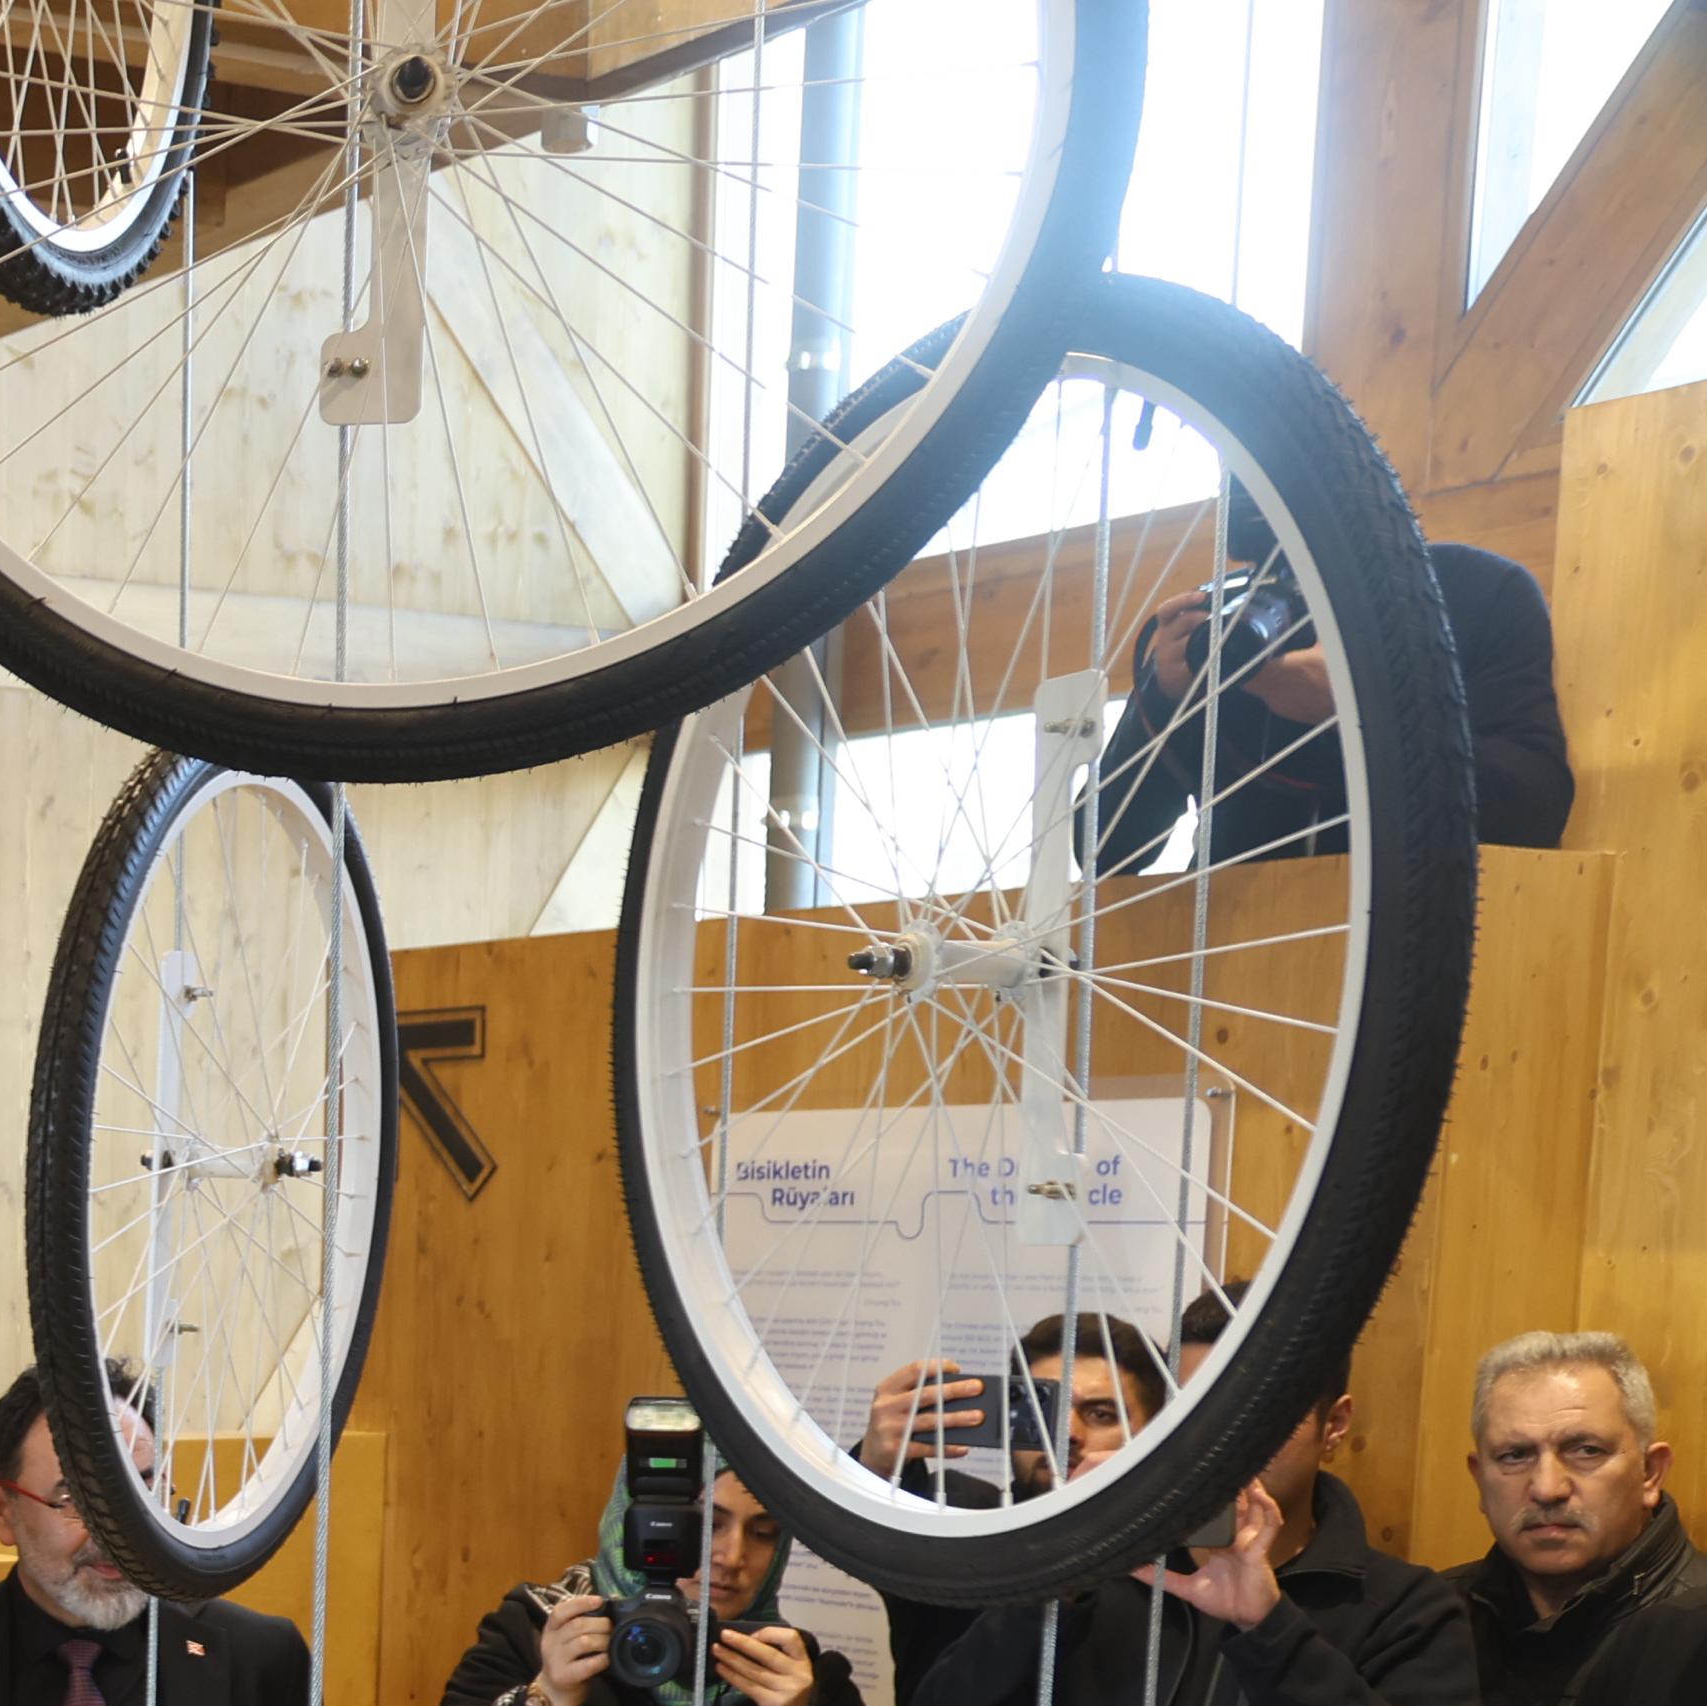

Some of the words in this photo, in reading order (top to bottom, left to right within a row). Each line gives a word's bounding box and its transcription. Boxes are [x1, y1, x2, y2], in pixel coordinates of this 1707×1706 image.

[737, 1159, 830, 1181] Bisikletin
[948, 1157, 990, 1178] The
[1096, 1155, 1121, 1176] of
[990, 1183, 1015, 1205] th
